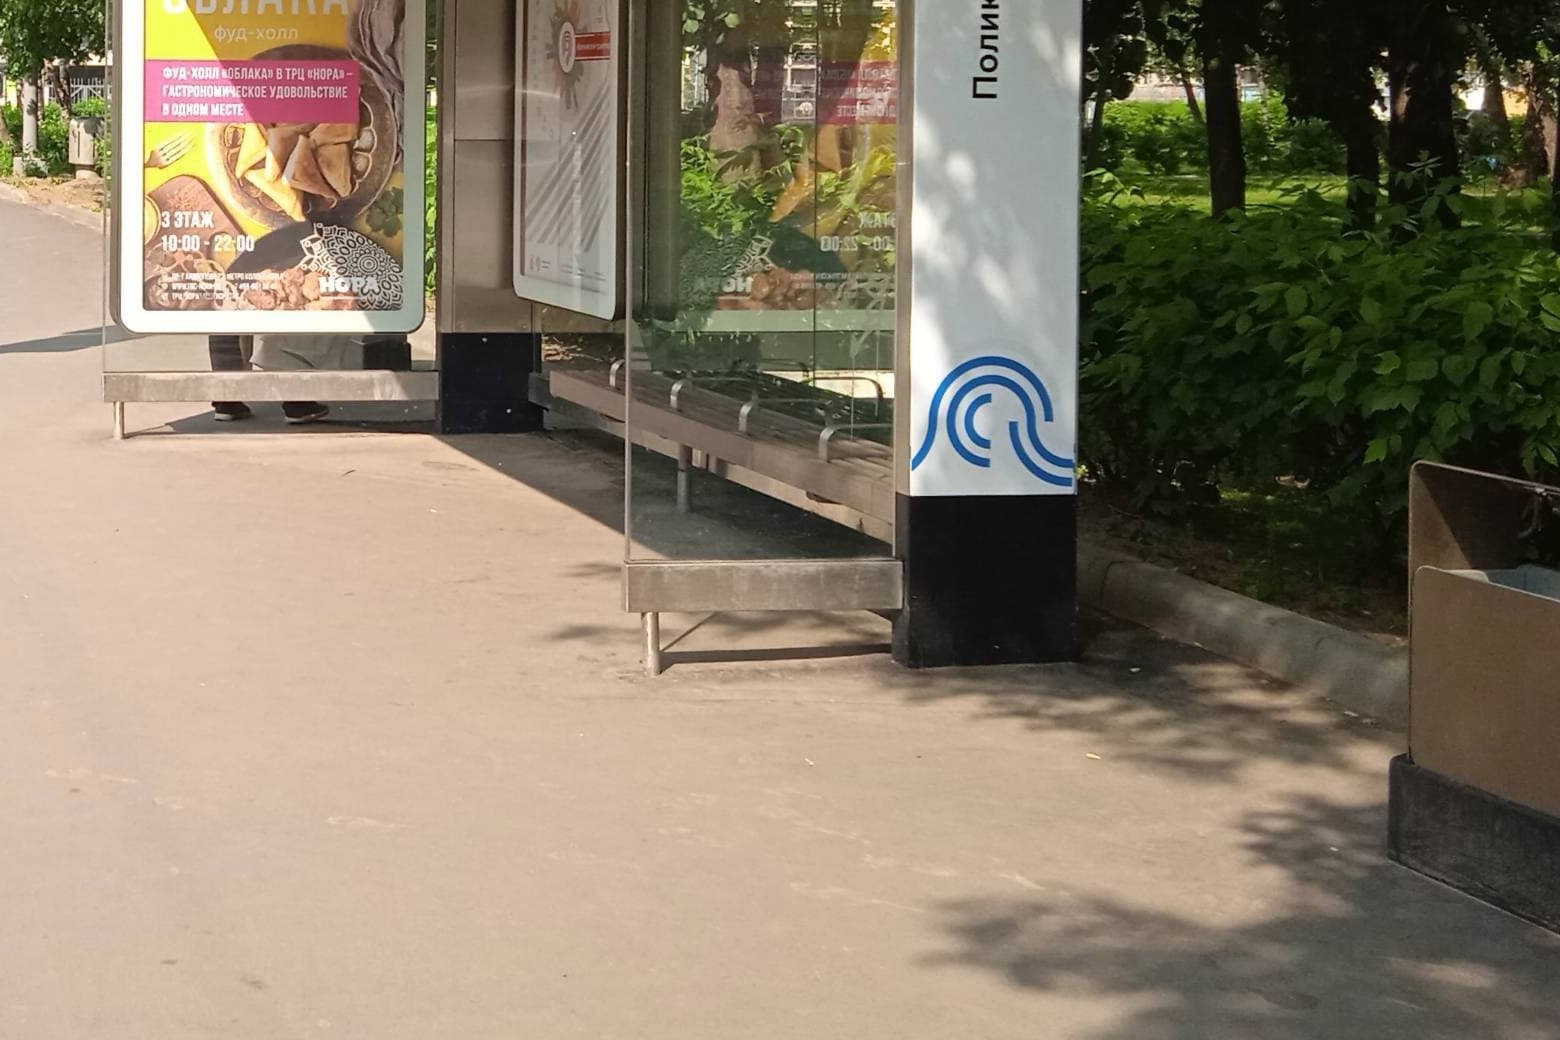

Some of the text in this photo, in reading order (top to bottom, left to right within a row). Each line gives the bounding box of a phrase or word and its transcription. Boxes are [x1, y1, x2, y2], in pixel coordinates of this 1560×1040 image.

[214, 25, 298, 42] фуд-холл
[163, 67, 219, 80] ФУД-ХОЛЛ
[276, 68, 283, 80] В
[285, 68, 305, 82] ТРЦ
[307, 68, 344, 81] «НОРА»
[162, 85, 348, 99] ГАСТРОНОМИЧЕСКОЕ УДОВОЛЬСТВИЕ
[162, 103, 244, 116] В ОДНОМ МЕСТЕ
[174, 211, 215, 228] ЭТАЖ
[161, 235, 200, 251] 10:00
[214, 235, 255, 252] 22:00
[319, 276, 381, 294] НОРА
